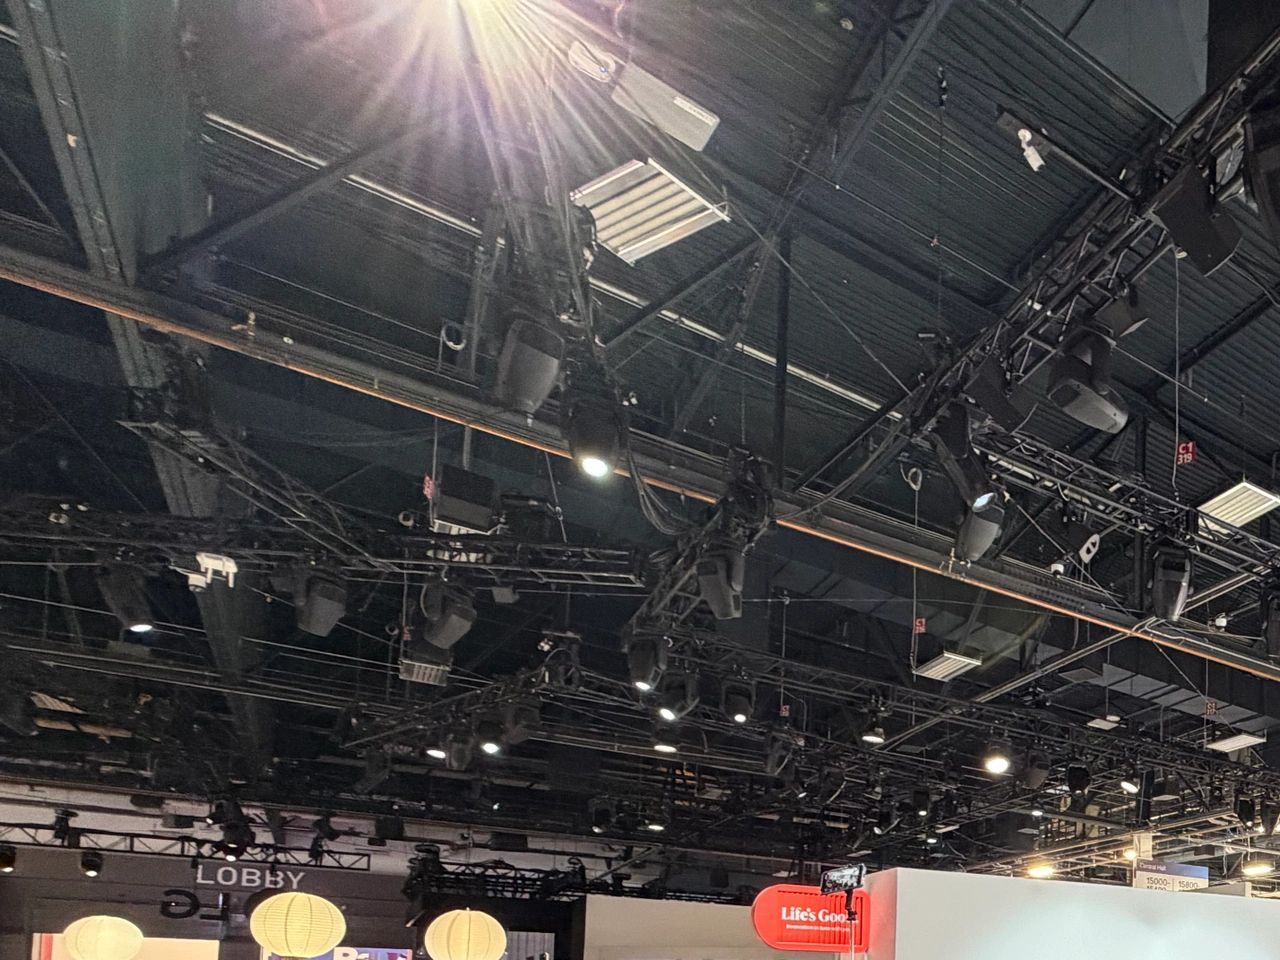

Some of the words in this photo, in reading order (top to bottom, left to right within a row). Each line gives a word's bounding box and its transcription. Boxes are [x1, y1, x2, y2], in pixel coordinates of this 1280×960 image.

[1178, 442, 1193, 453] C1
[1177, 453, 1193, 464] 319
[196, 865, 305, 889] LOBBY
[781, 907, 816, 921] Life's
